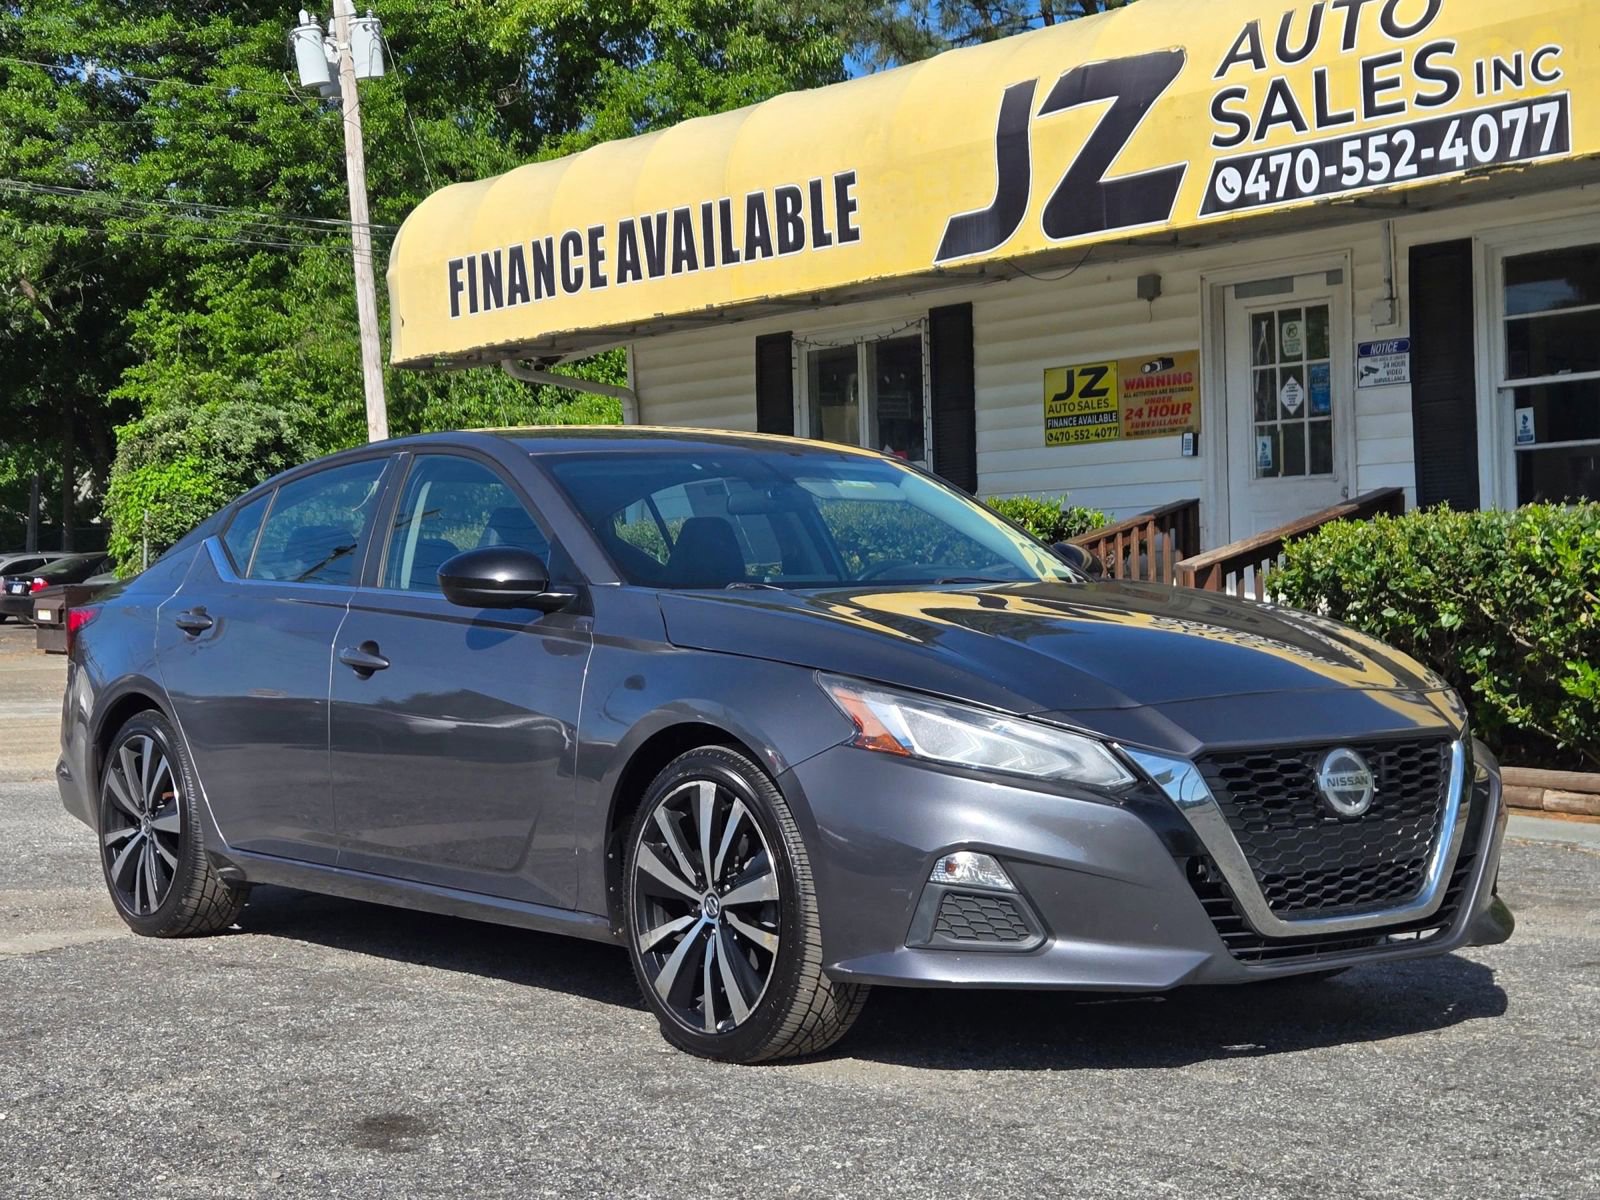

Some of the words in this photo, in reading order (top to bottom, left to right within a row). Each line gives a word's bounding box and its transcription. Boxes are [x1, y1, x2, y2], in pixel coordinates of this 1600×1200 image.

[1213, 0, 1444, 79] AUTO
[1209, 39, 1462, 148] SALES
[1473, 44, 1563, 96] INC
[934, 46, 1189, 264] JZ
[1244, 100, 1561, 201] 470-552-4077
[448, 223, 607, 319] FINANCE
[616, 169, 862, 285] AVAILABLE
[1371, 341, 1399, 355] NOTICE
[1051, 366, 1109, 401] JZ
[1124, 371, 1193, 390] WARNING
[1048, 400, 1076, 415] AUTO
[1077, 398, 1110, 412] SALES
[1144, 395, 1173, 405] UNDER
[1048, 418, 1077, 429] FINANCE
[1078, 412, 1117, 425] AVAILABLE
[1124, 407, 1144, 421] 24
[1148, 402, 1193, 418] HOUR
[1131, 416, 1190, 429] SURVEILLANCE
[1054, 426, 1119, 442] 470-552-4077
[1327, 776, 1368, 787] NISSAN
